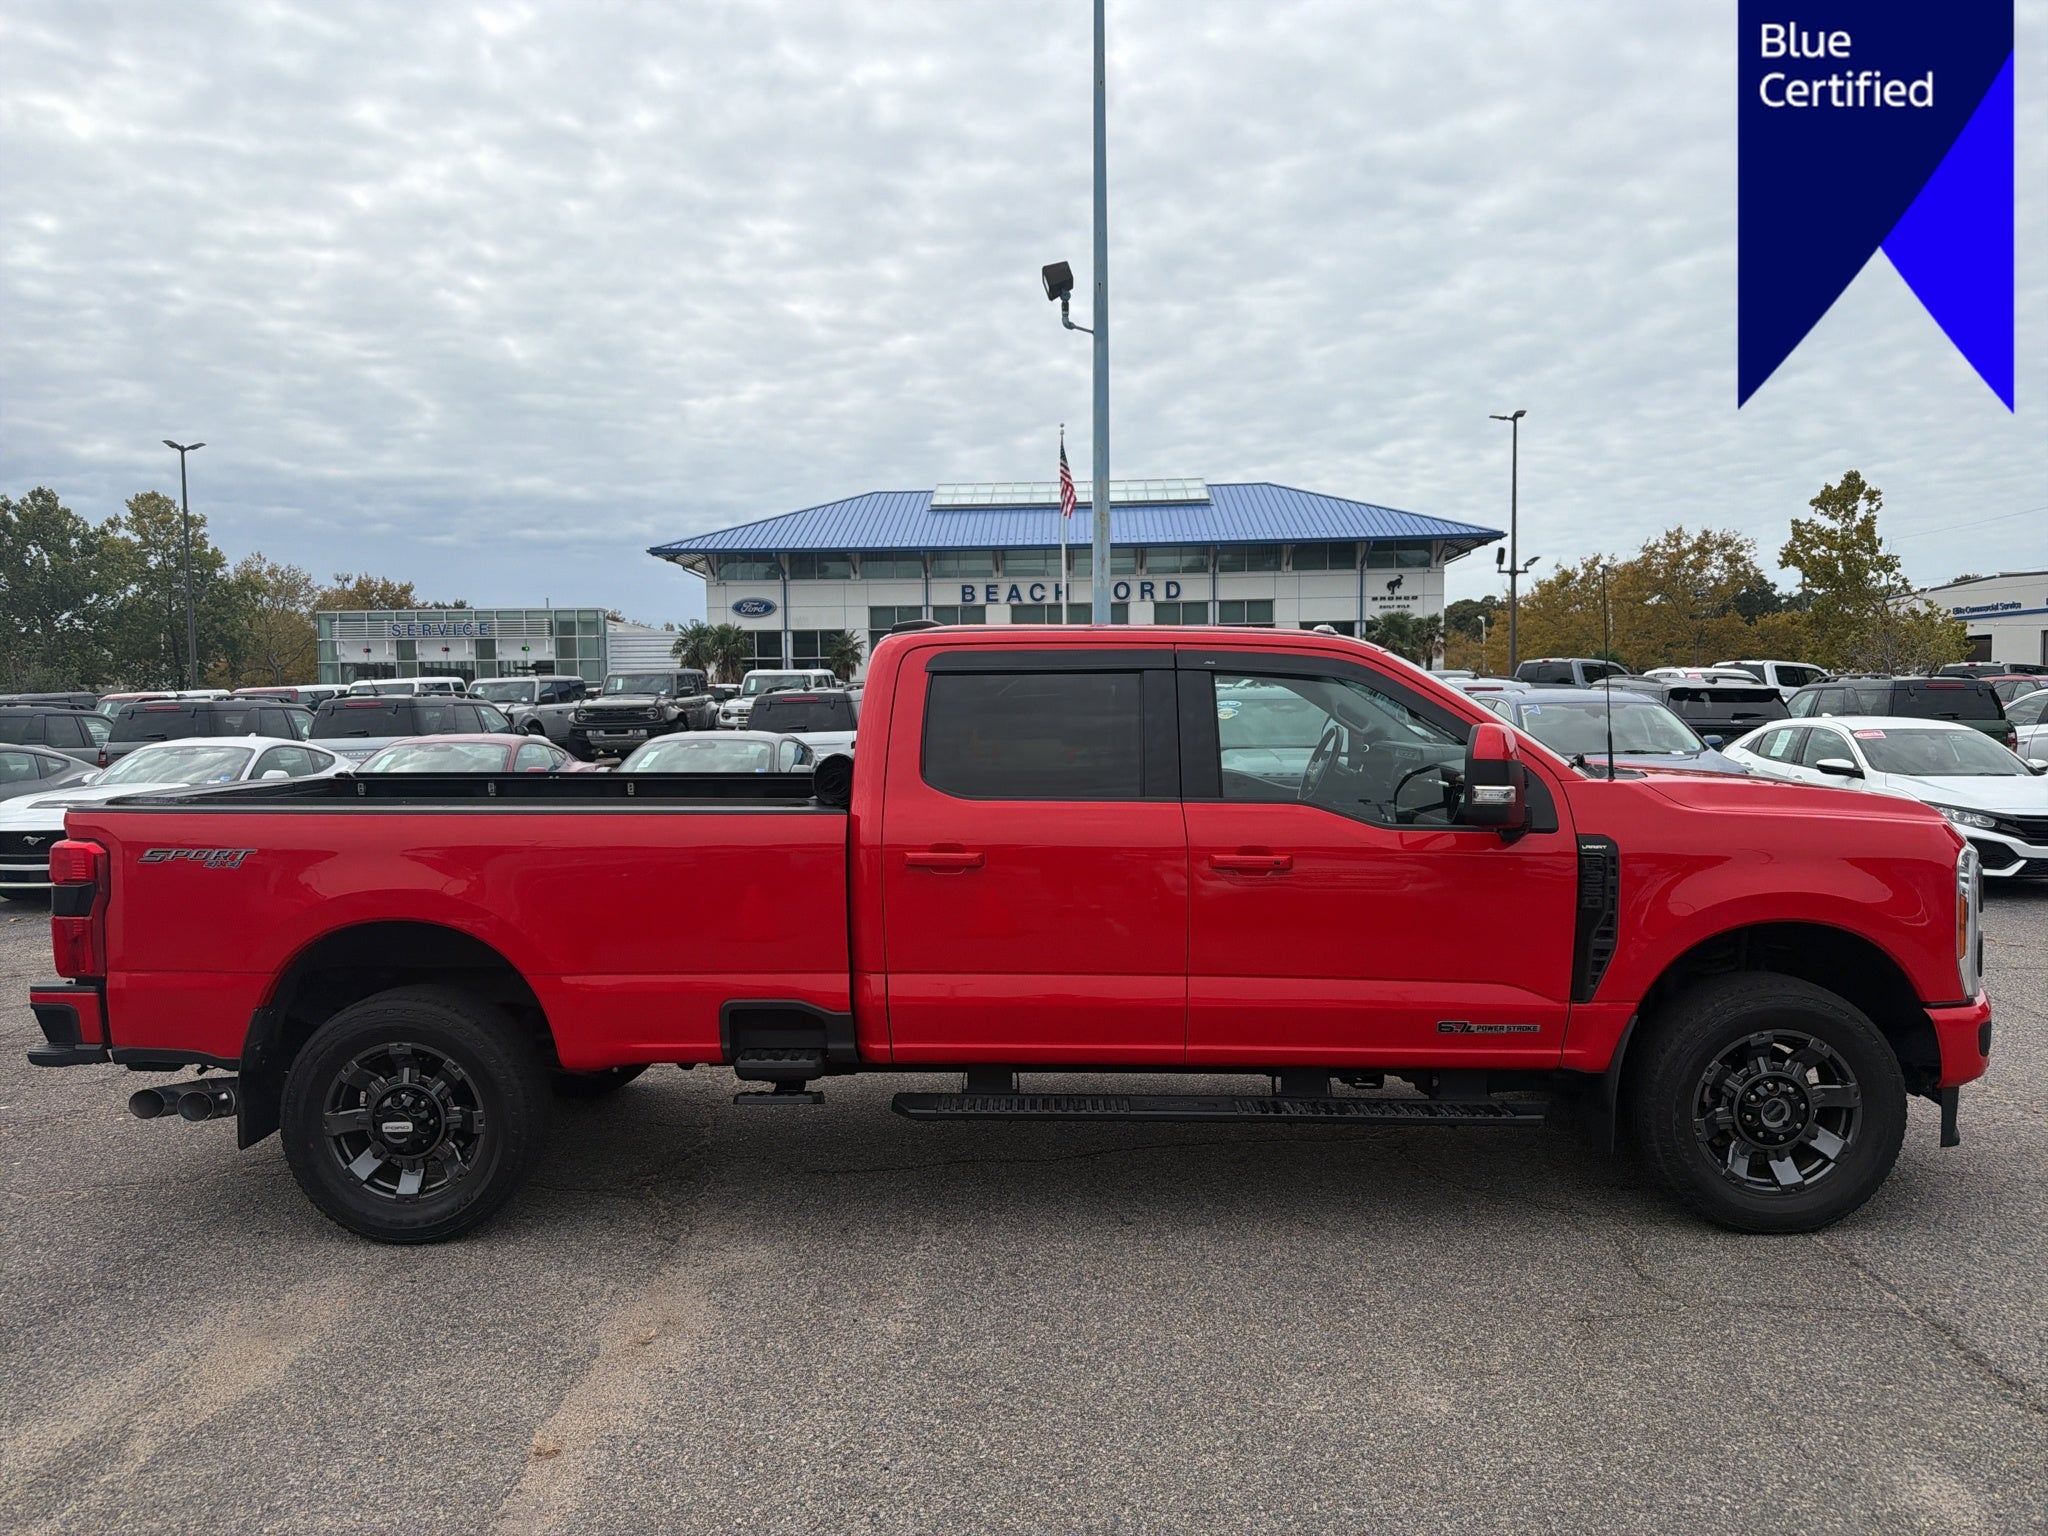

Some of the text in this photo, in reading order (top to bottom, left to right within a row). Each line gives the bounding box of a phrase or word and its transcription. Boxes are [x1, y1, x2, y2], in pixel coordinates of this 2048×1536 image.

[961, 581, 1181, 603] BEACH ORD
[740, 601, 766, 613] Ford
[391, 623, 488, 637] SERVICE
[138, 848, 258, 863] SPORT
[1438, 1021, 1476, 1033] 6.7L
